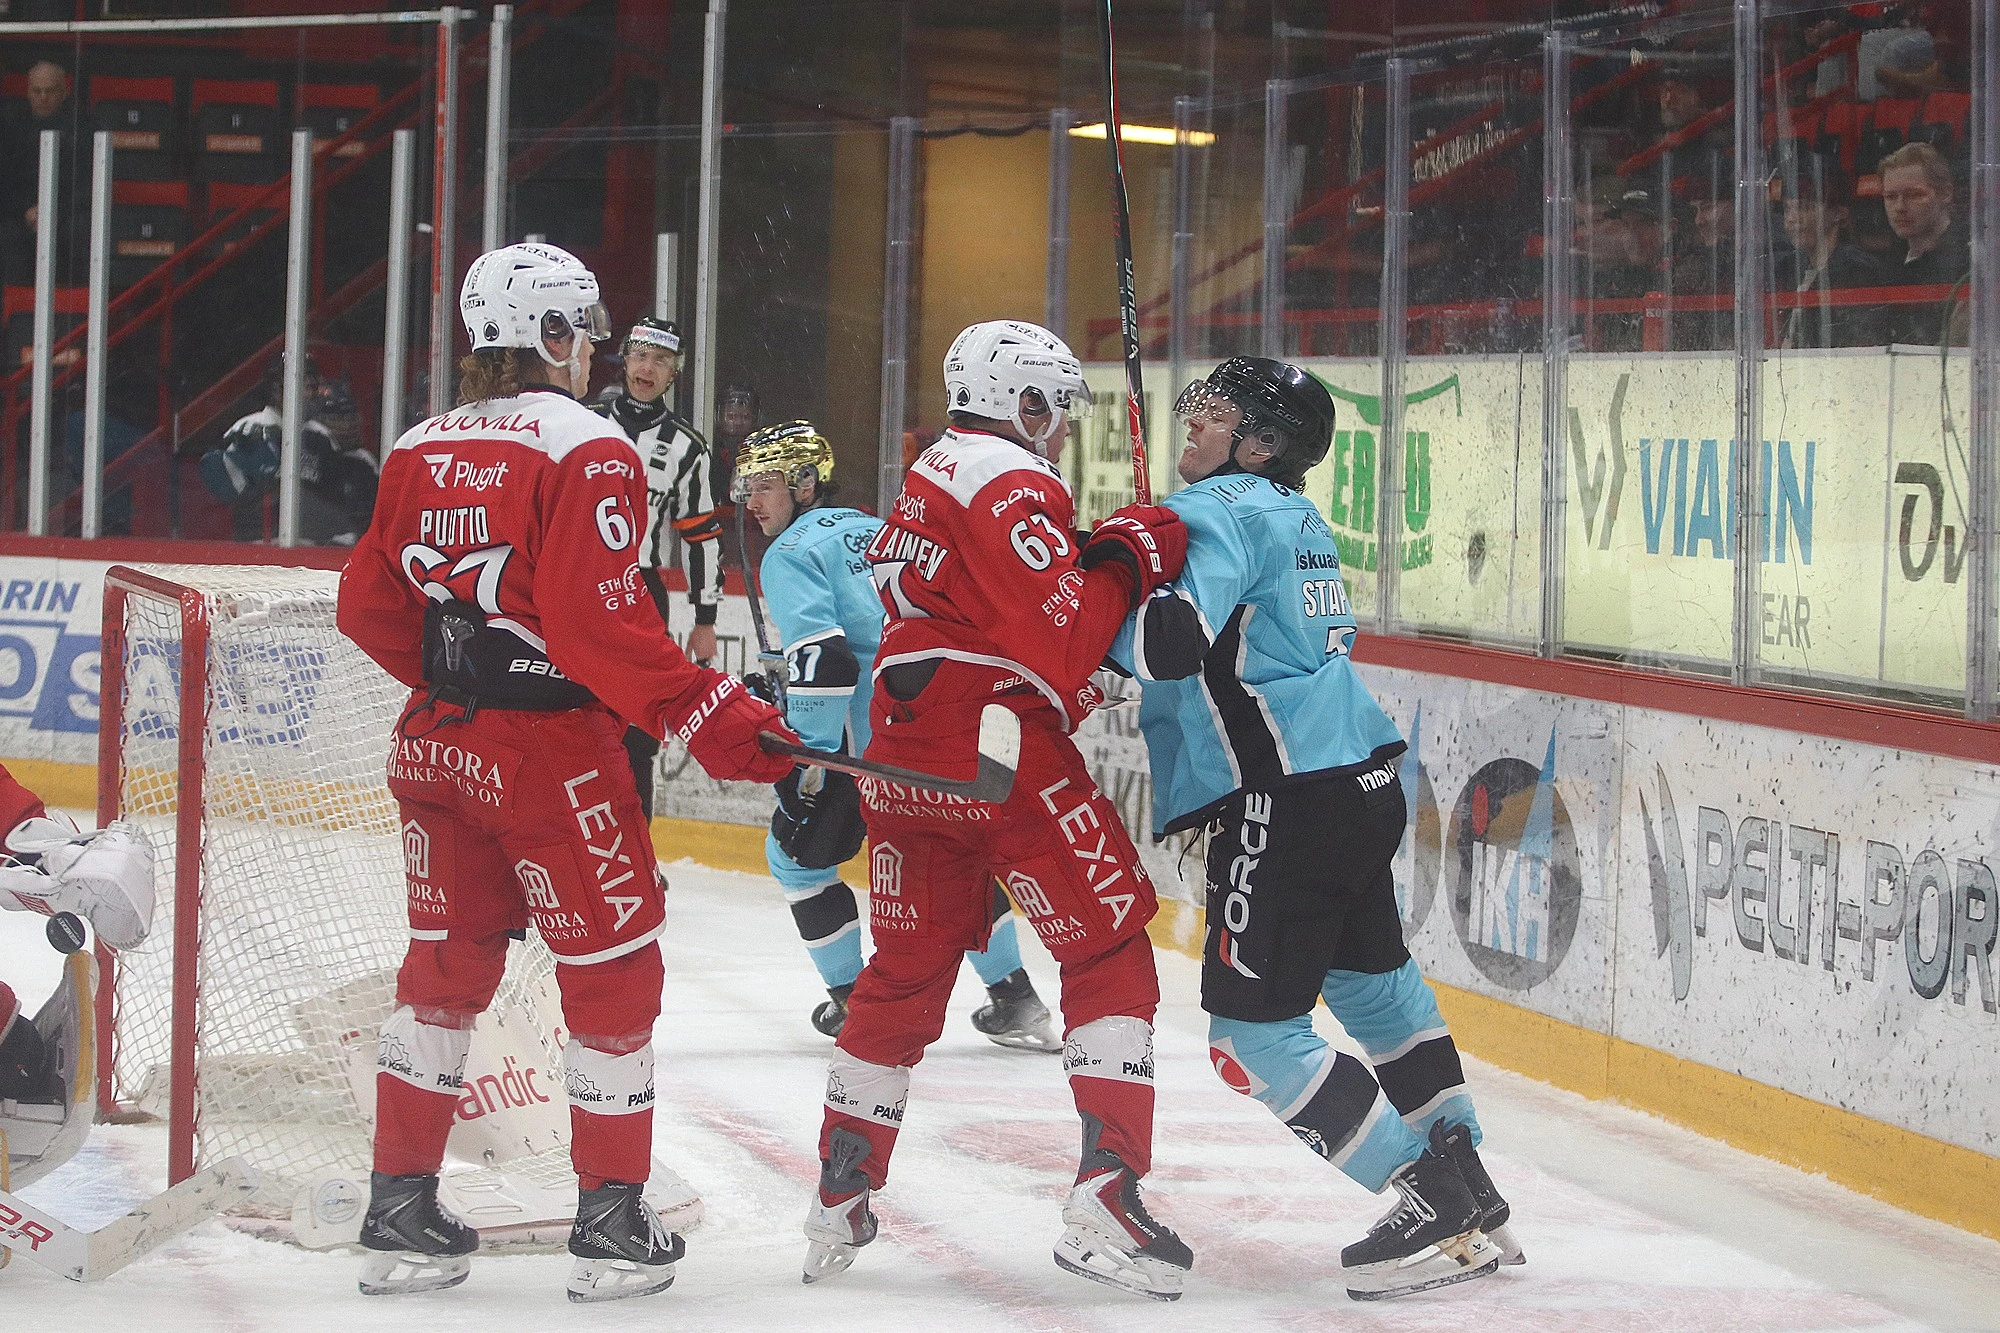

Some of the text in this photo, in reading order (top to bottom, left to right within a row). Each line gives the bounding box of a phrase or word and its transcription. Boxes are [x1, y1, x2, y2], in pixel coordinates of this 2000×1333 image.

[540, 281, 570, 289] BAUER
[1022, 359, 1054, 367] BAUER
[454, 461, 510, 492] Plugit
[991, 487, 1046, 518] PORI
[420, 505, 490, 547] PUUTIO
[595, 495, 638, 552] 6
[0, 579, 81, 613] RIN
[598, 579, 622, 595] ETH
[1041, 592, 1063, 616] ETH
[1761, 592, 1812, 650] EAR
[677, 673, 744, 745] BAUER
[478, 786, 504, 807] OY
[967, 807, 991, 821] OY
[564, 769, 643, 932] LEXIA
[1039, 777, 1135, 931] LEXIA
[1219, 792, 1273, 980] FORCE
[432, 904, 448, 915] OY
[573, 928, 589, 938] OY
[900, 920, 919, 931] OY
[1071, 928, 1088, 941] OY
[1125, 1211, 1158, 1240] BAUER
